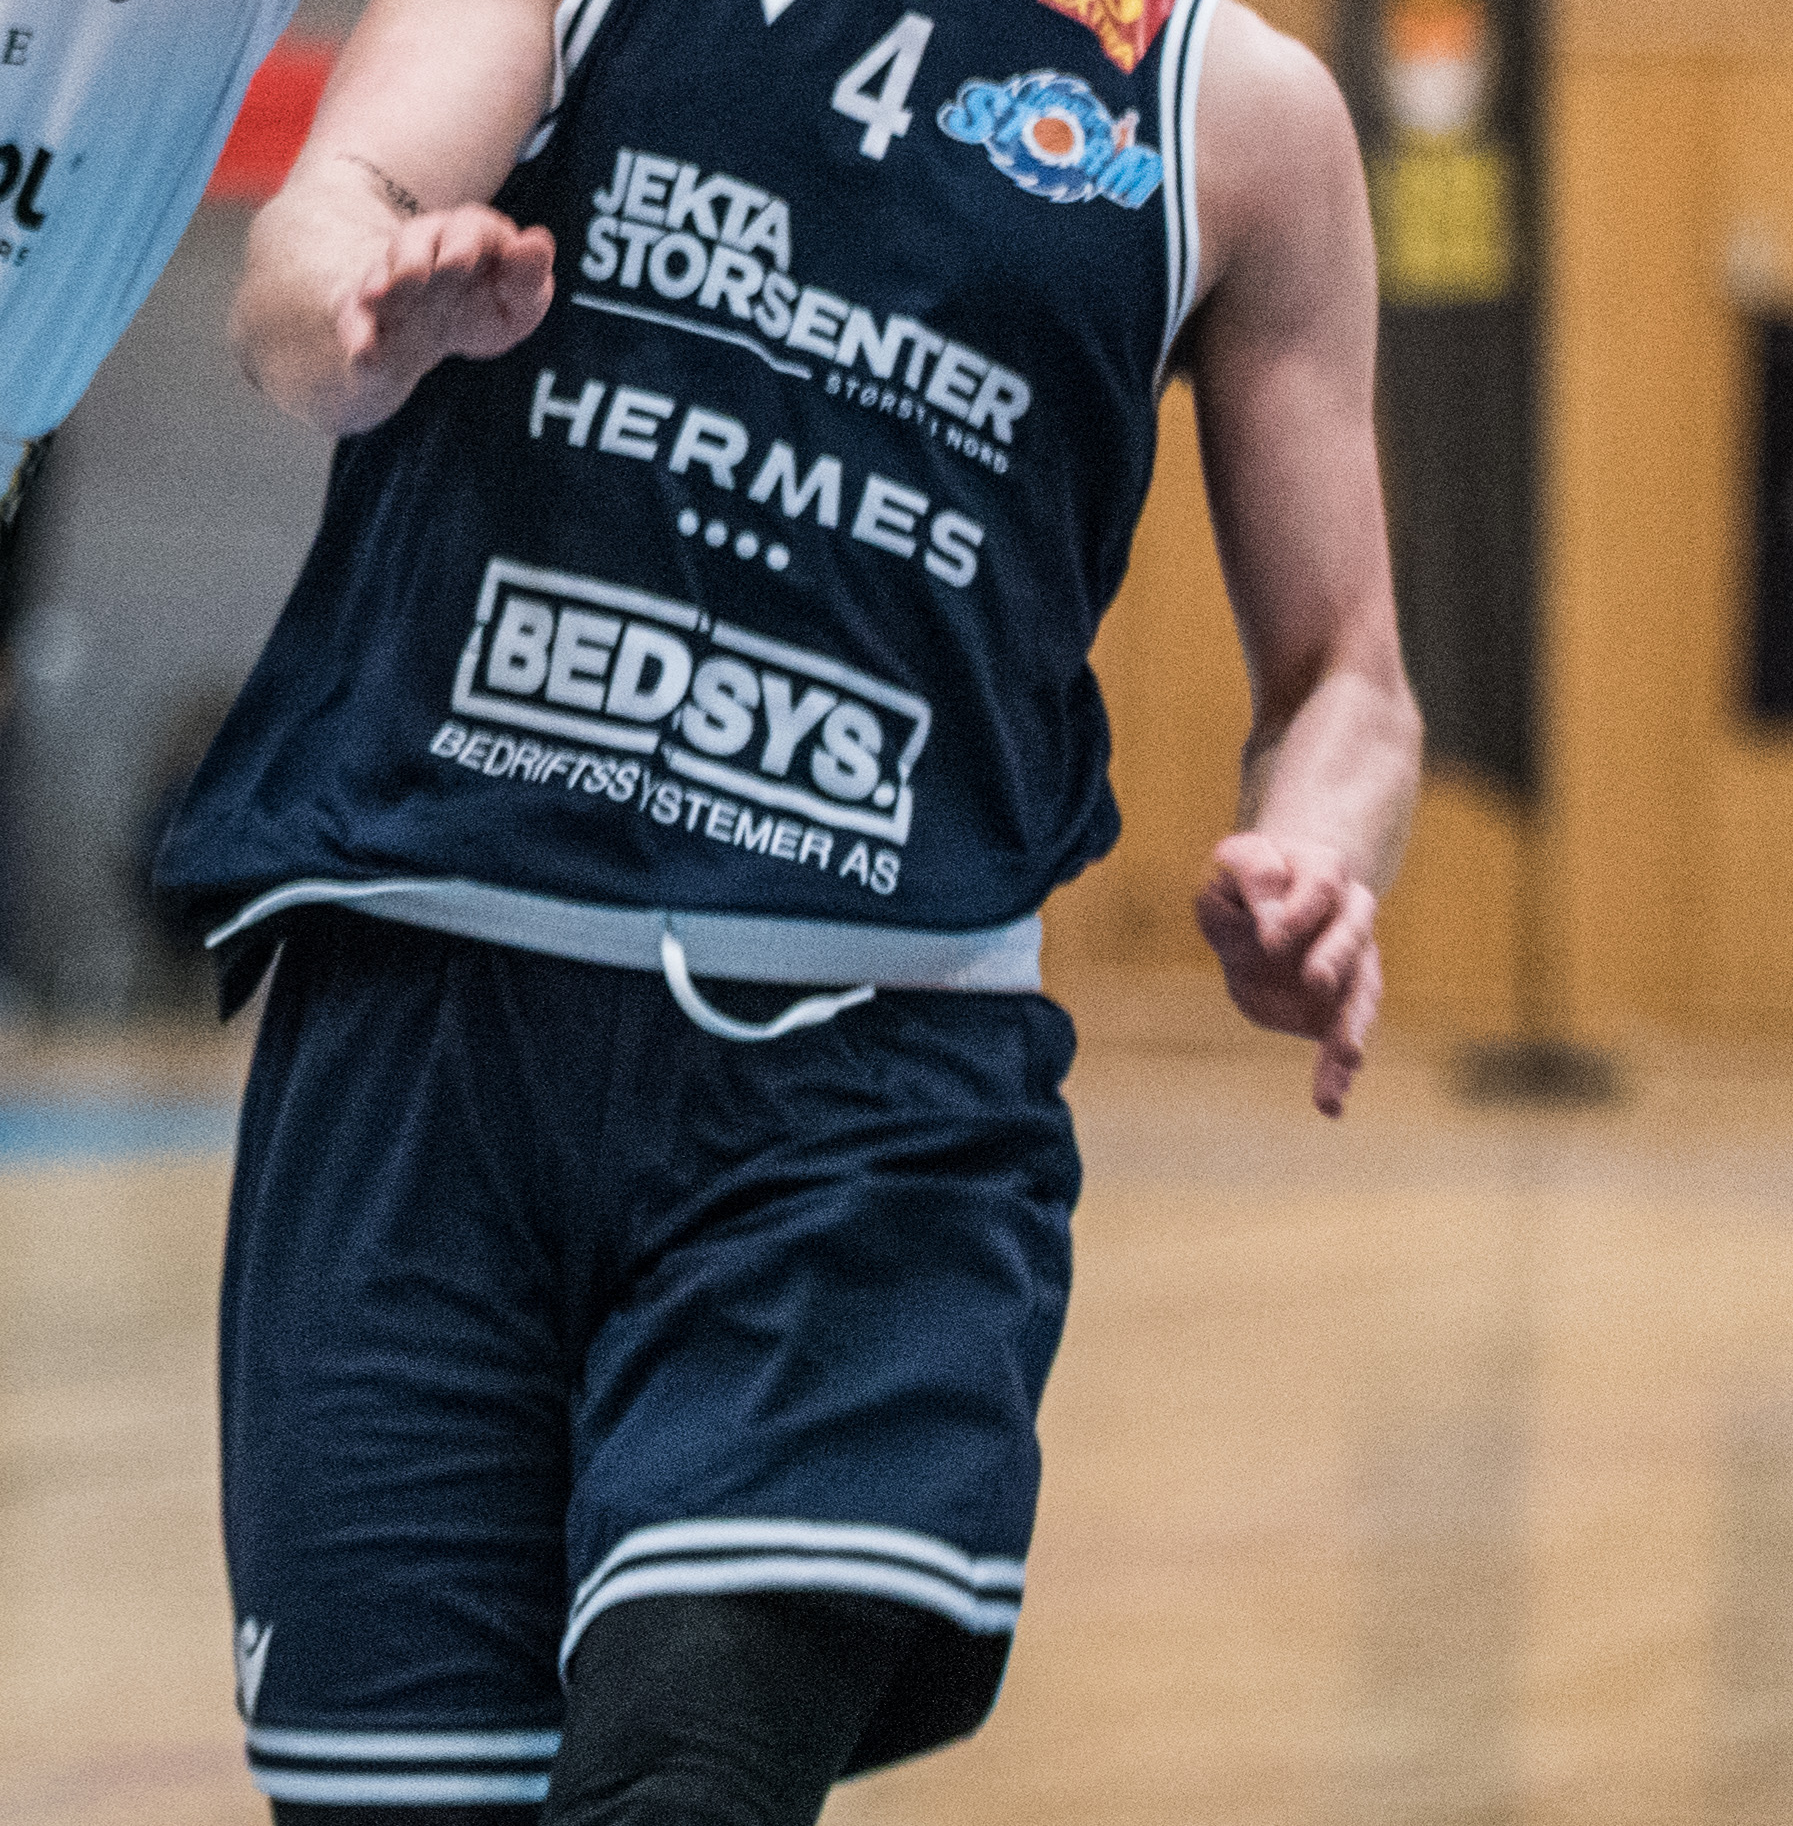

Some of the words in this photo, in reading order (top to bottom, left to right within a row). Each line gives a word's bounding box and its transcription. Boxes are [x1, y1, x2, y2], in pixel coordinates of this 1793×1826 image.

[830, 10, 935, 162] 4
[594, 148, 791, 270] JEKTA
[581, 215, 1031, 445] STORSENTER
[528, 371, 985, 589] HERMES
[430, 720, 834, 872] BEDRIFTSSYSTEMER
[838, 842, 903, 896] AS
